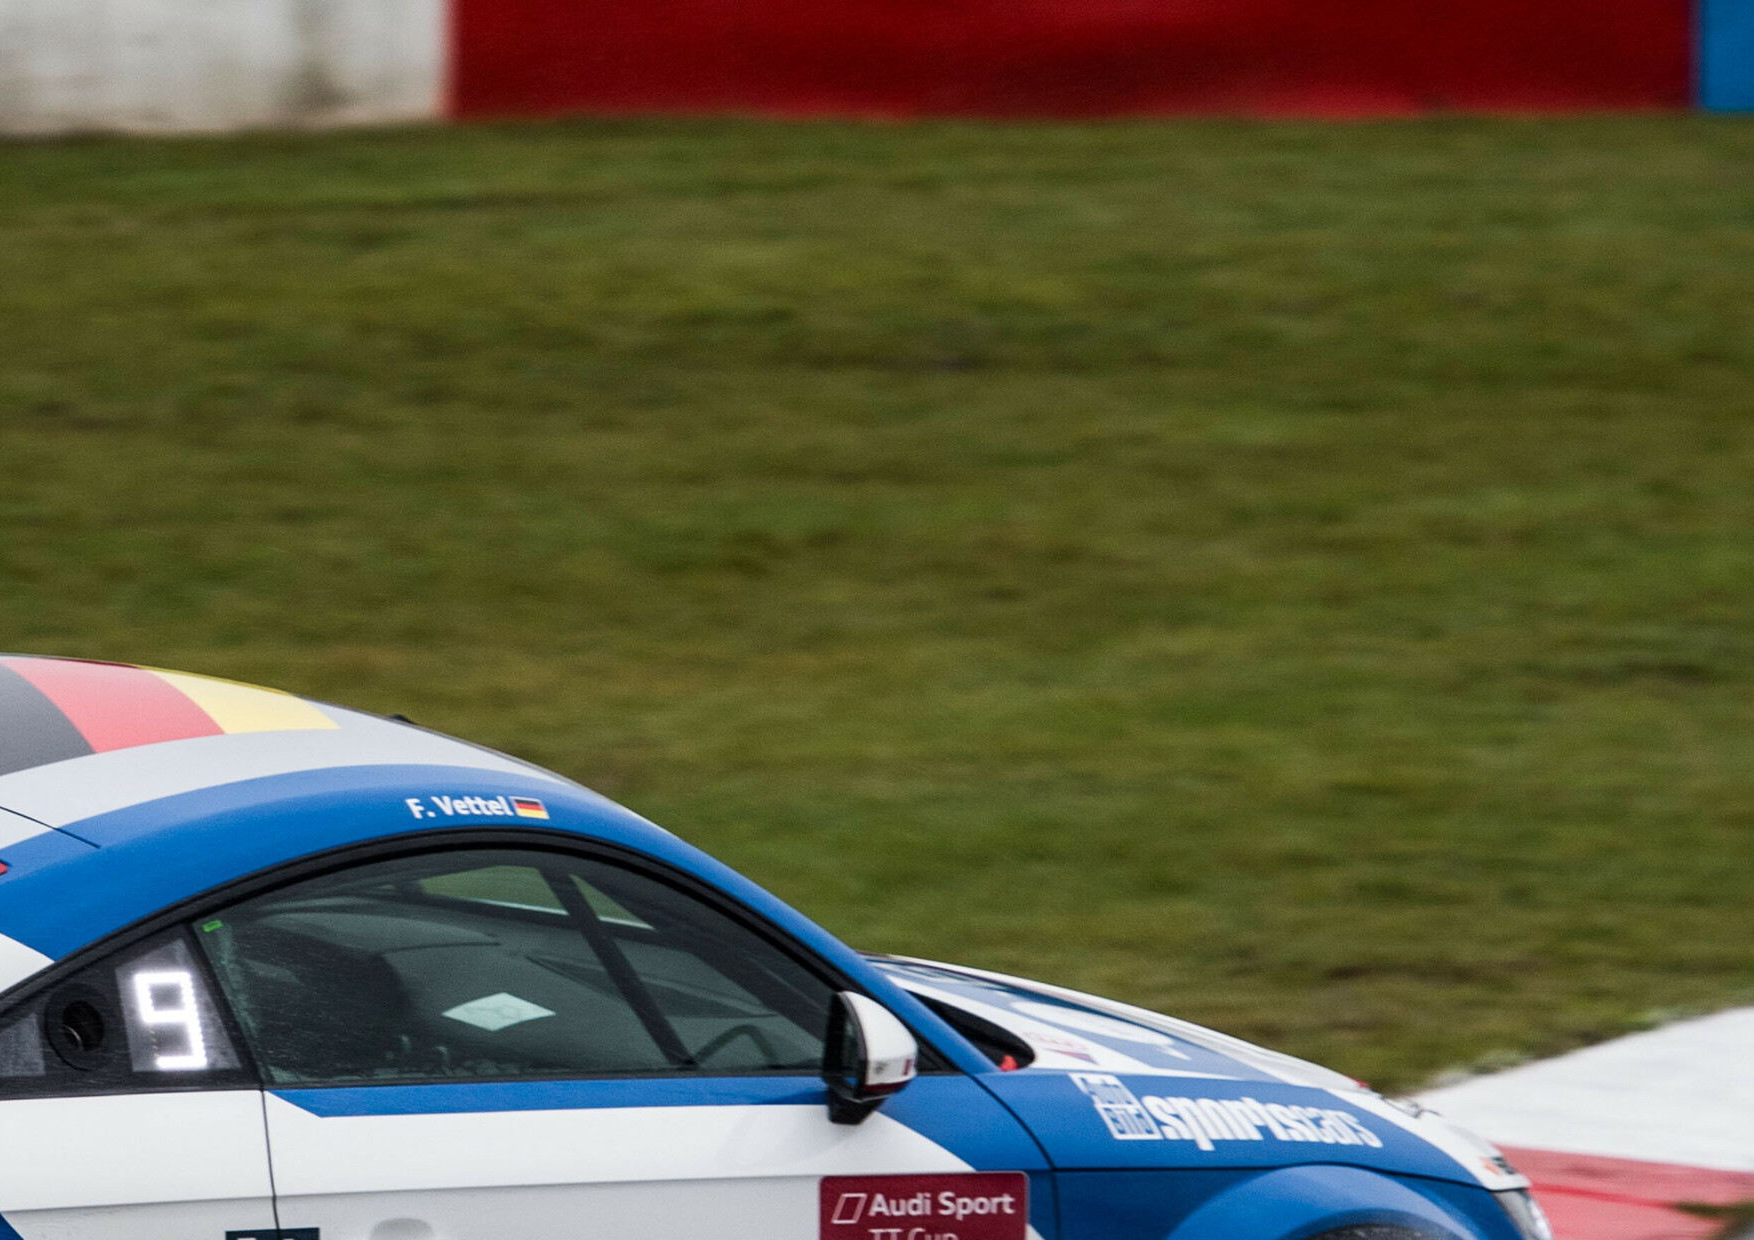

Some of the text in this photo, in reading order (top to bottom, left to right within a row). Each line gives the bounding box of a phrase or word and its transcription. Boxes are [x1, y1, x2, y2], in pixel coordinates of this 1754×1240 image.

[405, 795, 514, 819] F. Vettel
[134, 971, 207, 1069] 9
[868, 1191, 1016, 1221] Audi Sport
